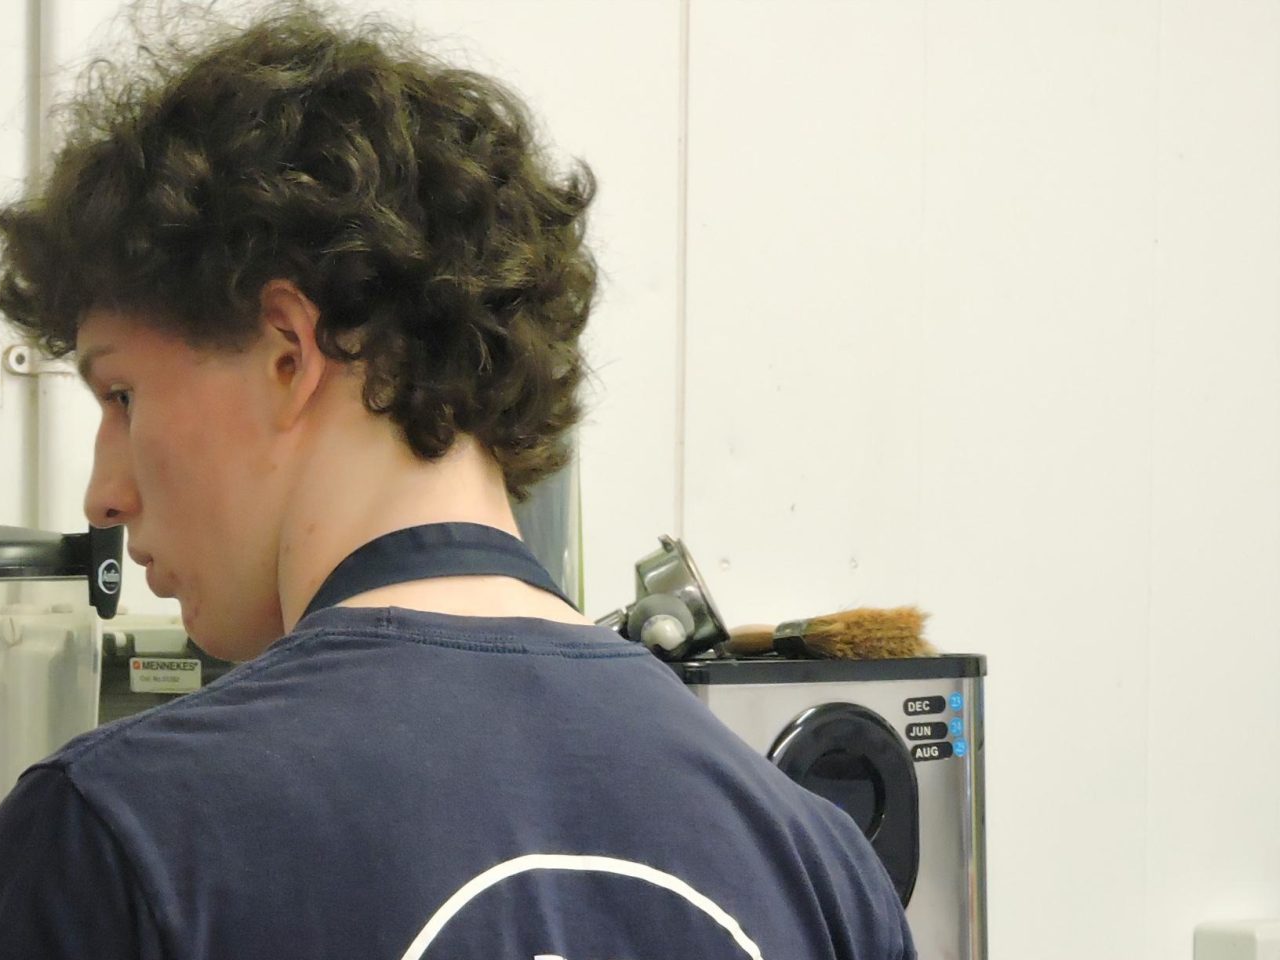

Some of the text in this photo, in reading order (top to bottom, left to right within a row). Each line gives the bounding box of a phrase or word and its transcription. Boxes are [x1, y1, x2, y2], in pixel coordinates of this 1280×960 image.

[141, 661, 196, 671] MENNEKES
[907, 701, 930, 712] DEC
[909, 726, 932, 736] JUN
[915, 746, 939, 758] AUG
